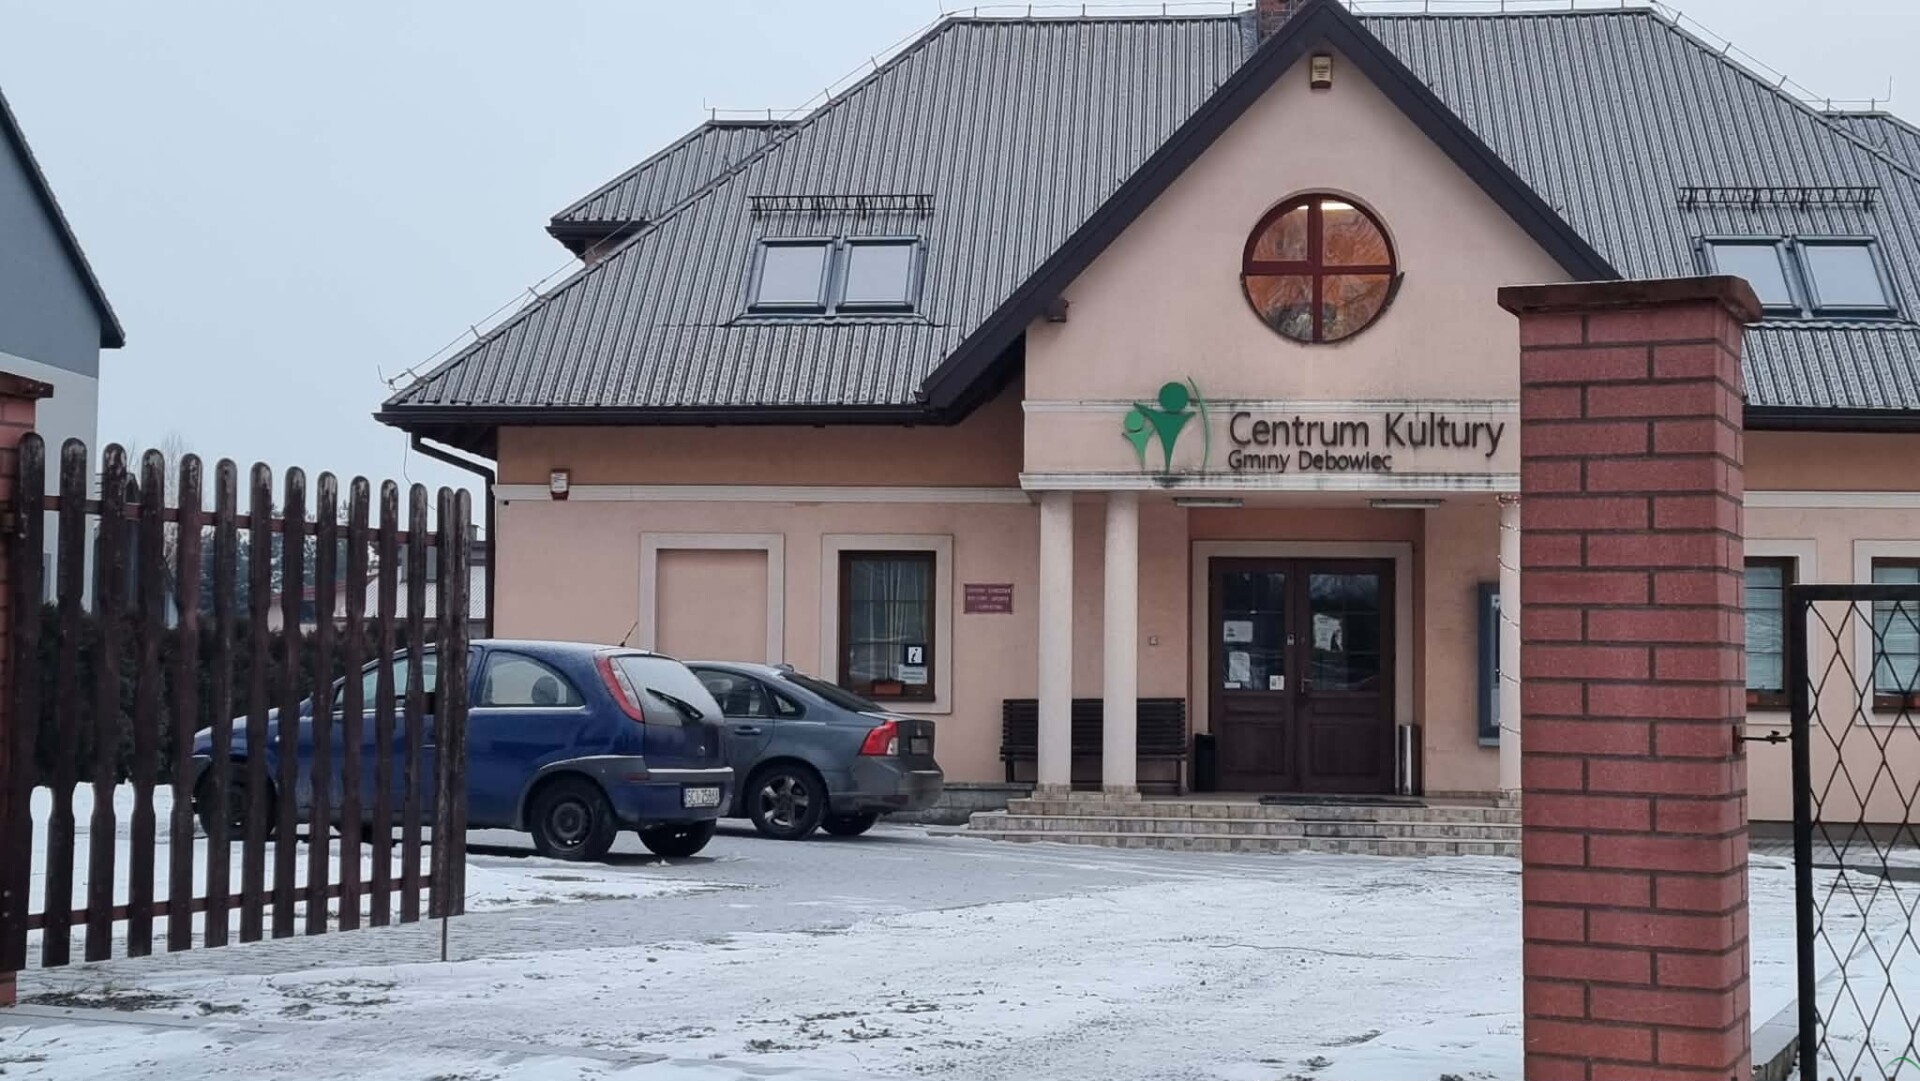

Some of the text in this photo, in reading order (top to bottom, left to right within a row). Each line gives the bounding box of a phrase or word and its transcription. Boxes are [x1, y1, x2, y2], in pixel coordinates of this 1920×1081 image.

[1230, 411, 1505, 457] Centrum Kultury
[1228, 449, 1290, 473] Gminy
